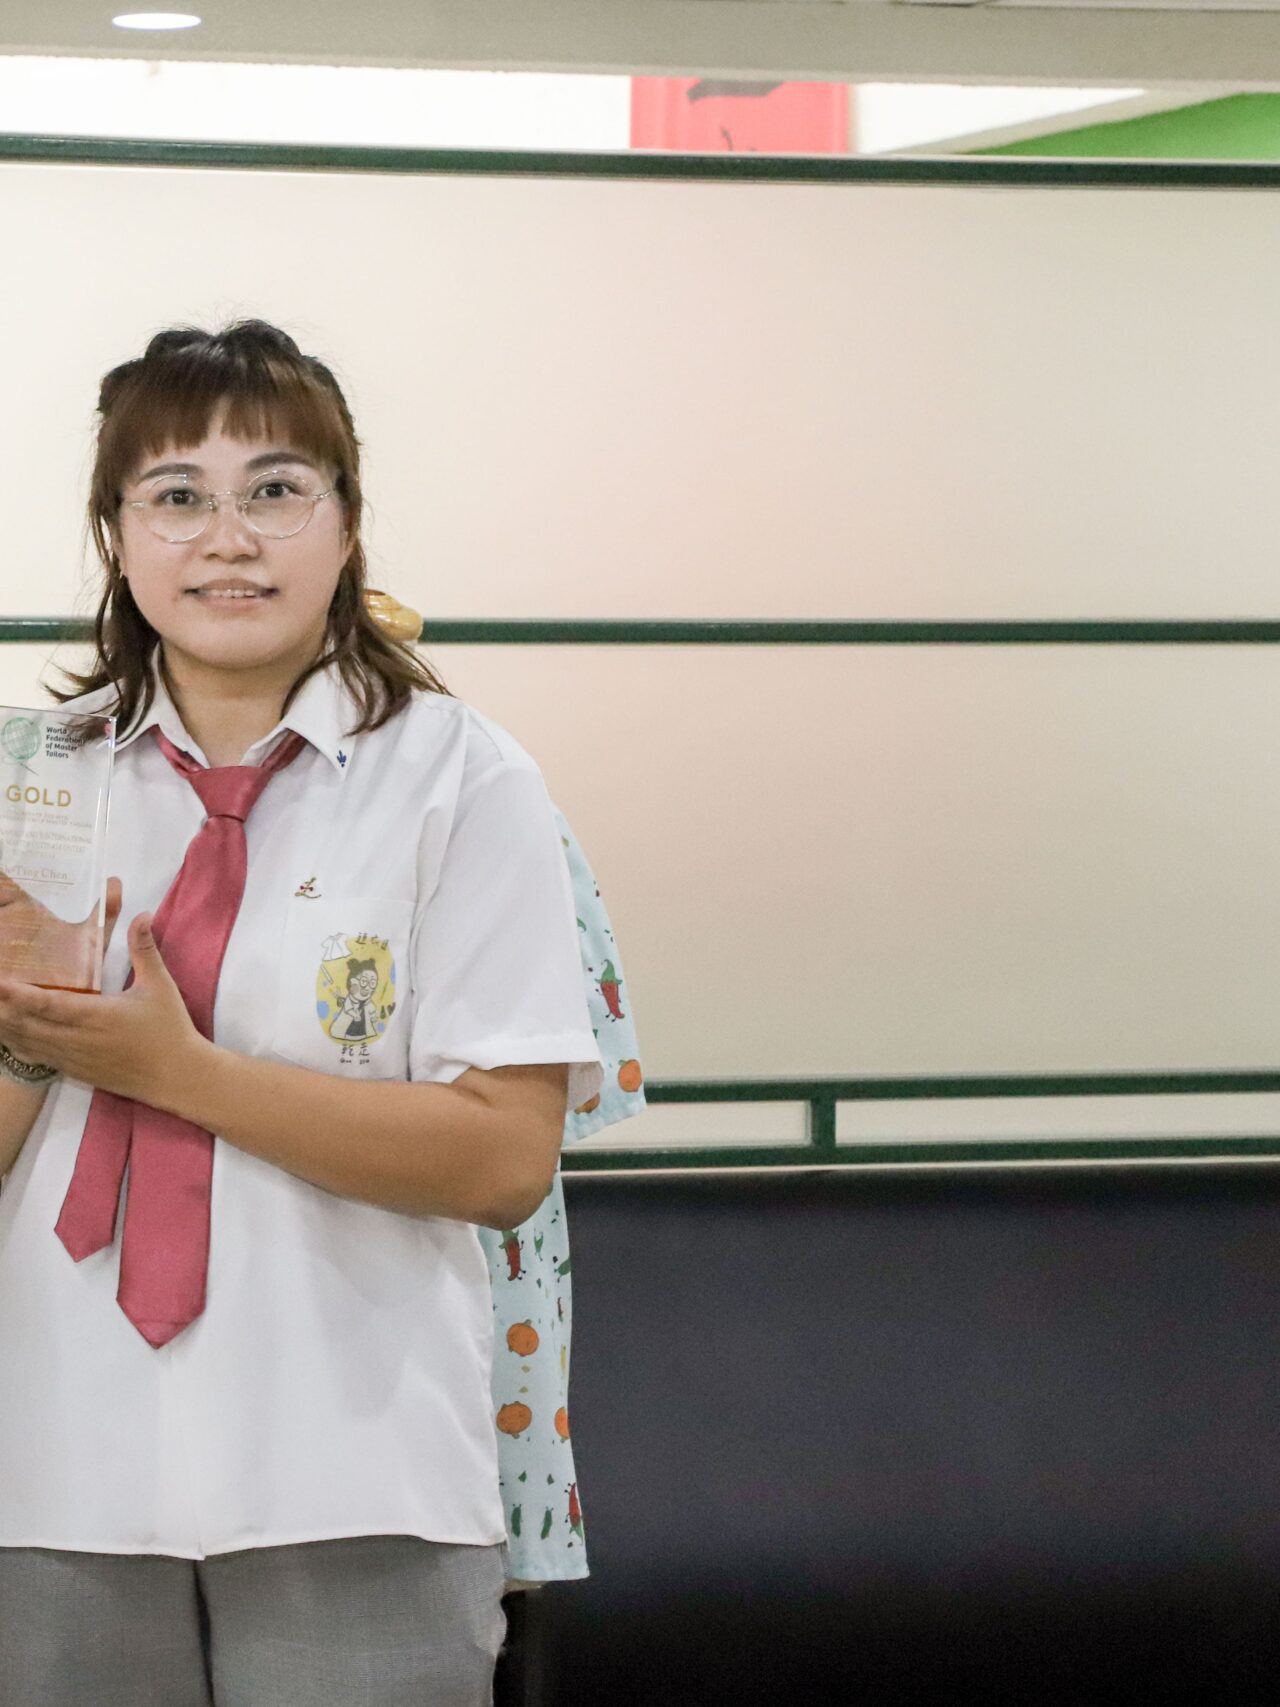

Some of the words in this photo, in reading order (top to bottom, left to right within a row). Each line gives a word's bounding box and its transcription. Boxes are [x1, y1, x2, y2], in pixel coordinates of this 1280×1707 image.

[46, 726, 67, 734] World
[45, 742, 53, 750] of
[54, 743, 77, 751] Master
[46, 750, 69, 759] Tailors
[5, 784, 72, 808] GOLD
